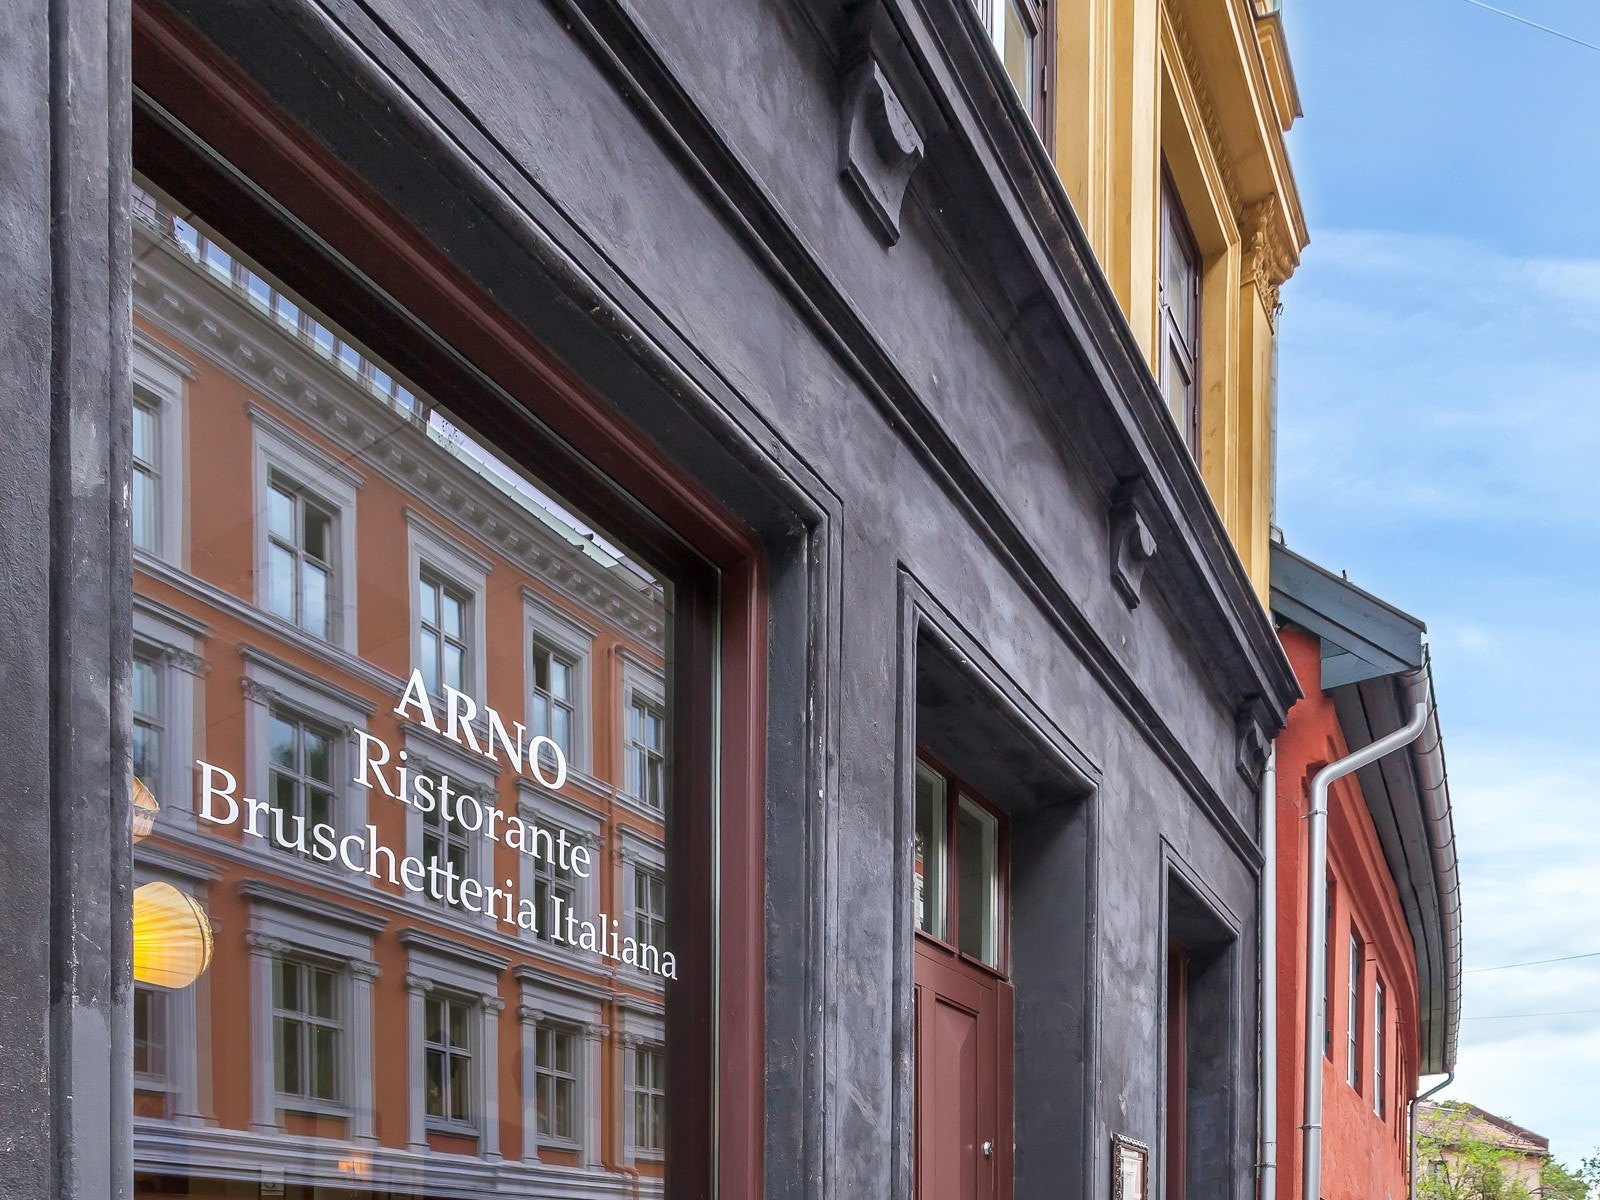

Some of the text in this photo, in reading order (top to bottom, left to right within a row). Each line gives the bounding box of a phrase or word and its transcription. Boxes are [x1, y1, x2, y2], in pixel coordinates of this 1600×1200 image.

[353, 728, 591, 878] Ristorante
[393, 667, 567, 790] ARNO
[196, 759, 678, 980] Bruschetteria Italiana
